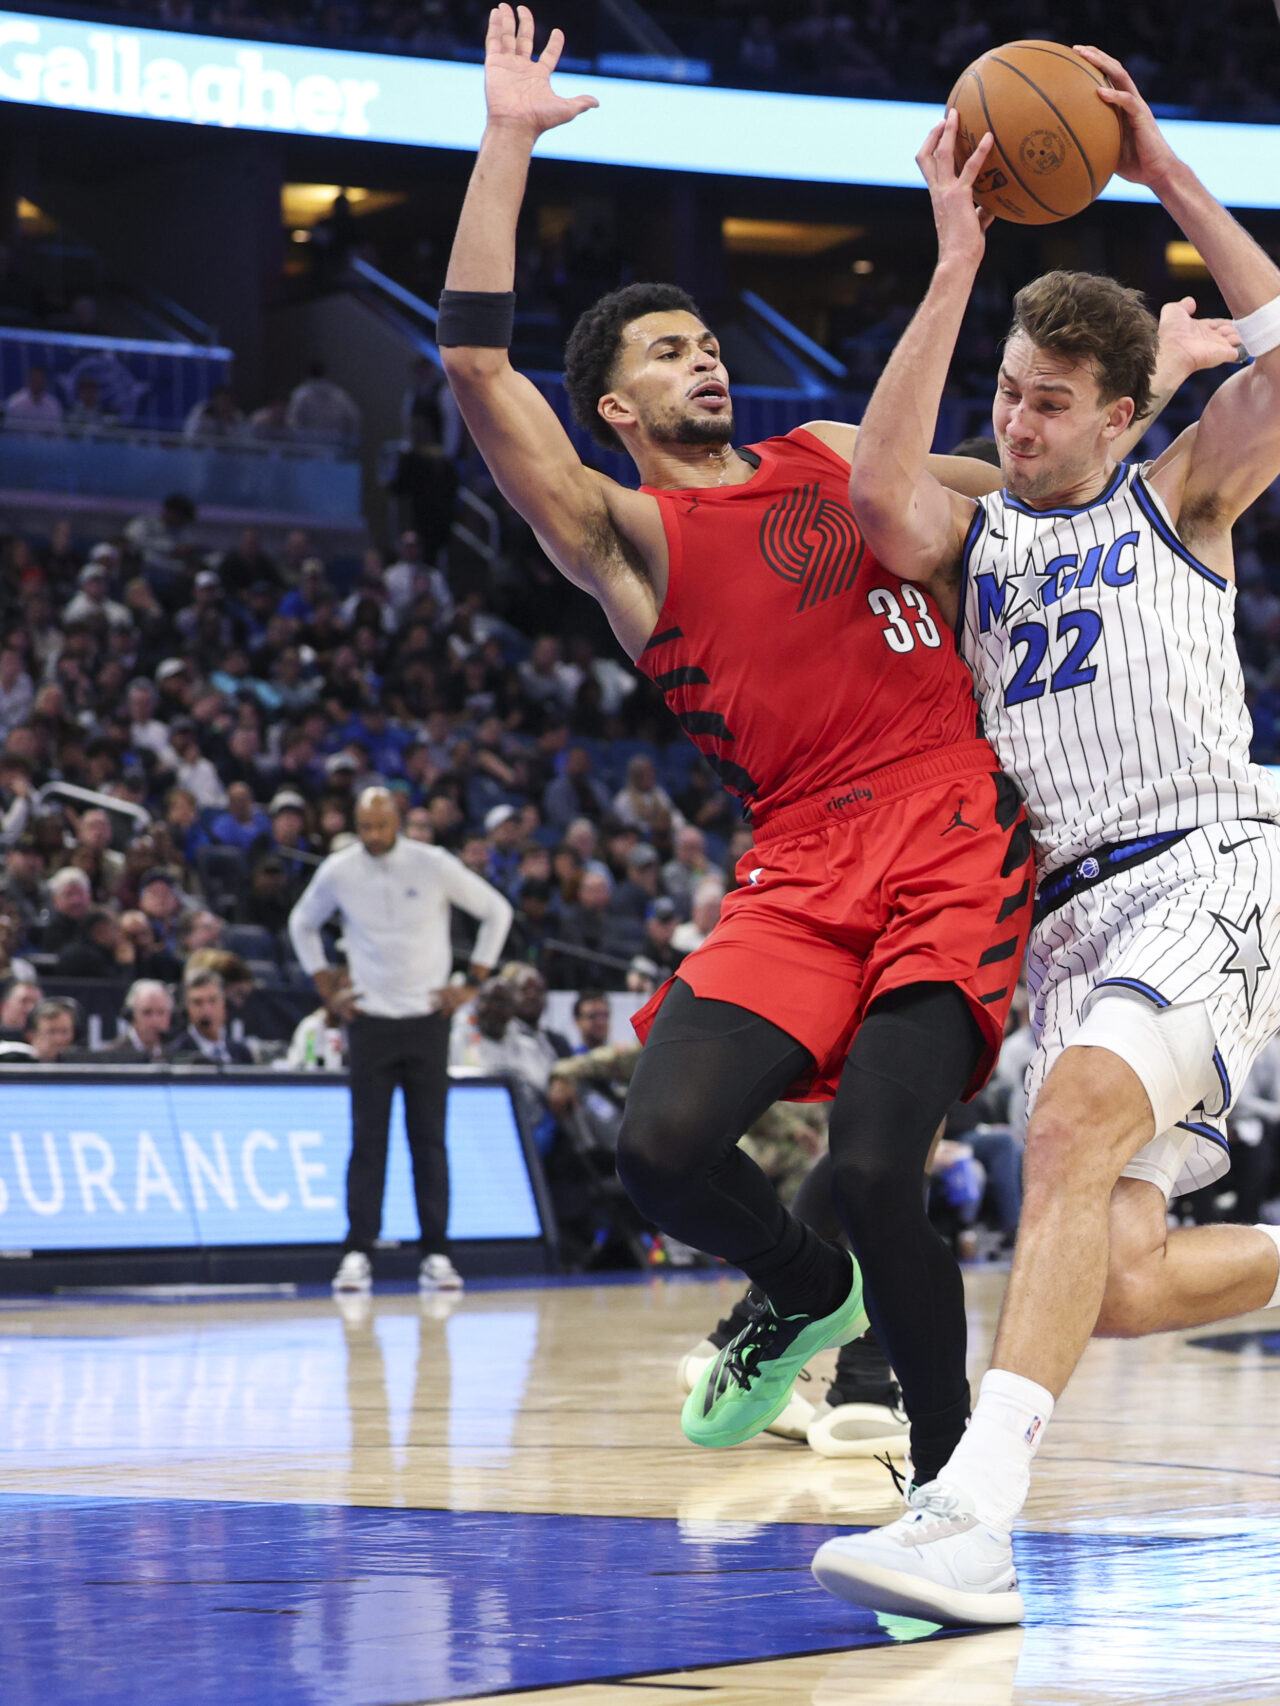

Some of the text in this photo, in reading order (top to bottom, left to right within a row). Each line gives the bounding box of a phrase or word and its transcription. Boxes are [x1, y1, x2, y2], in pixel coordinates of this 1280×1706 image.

[0, 20, 379, 136] Gallagher
[867, 583, 942, 654] 33
[1003, 608, 1103, 709] 22
[826, 786, 873, 812] ripcity
[0, 1129, 338, 1216] URANCE
